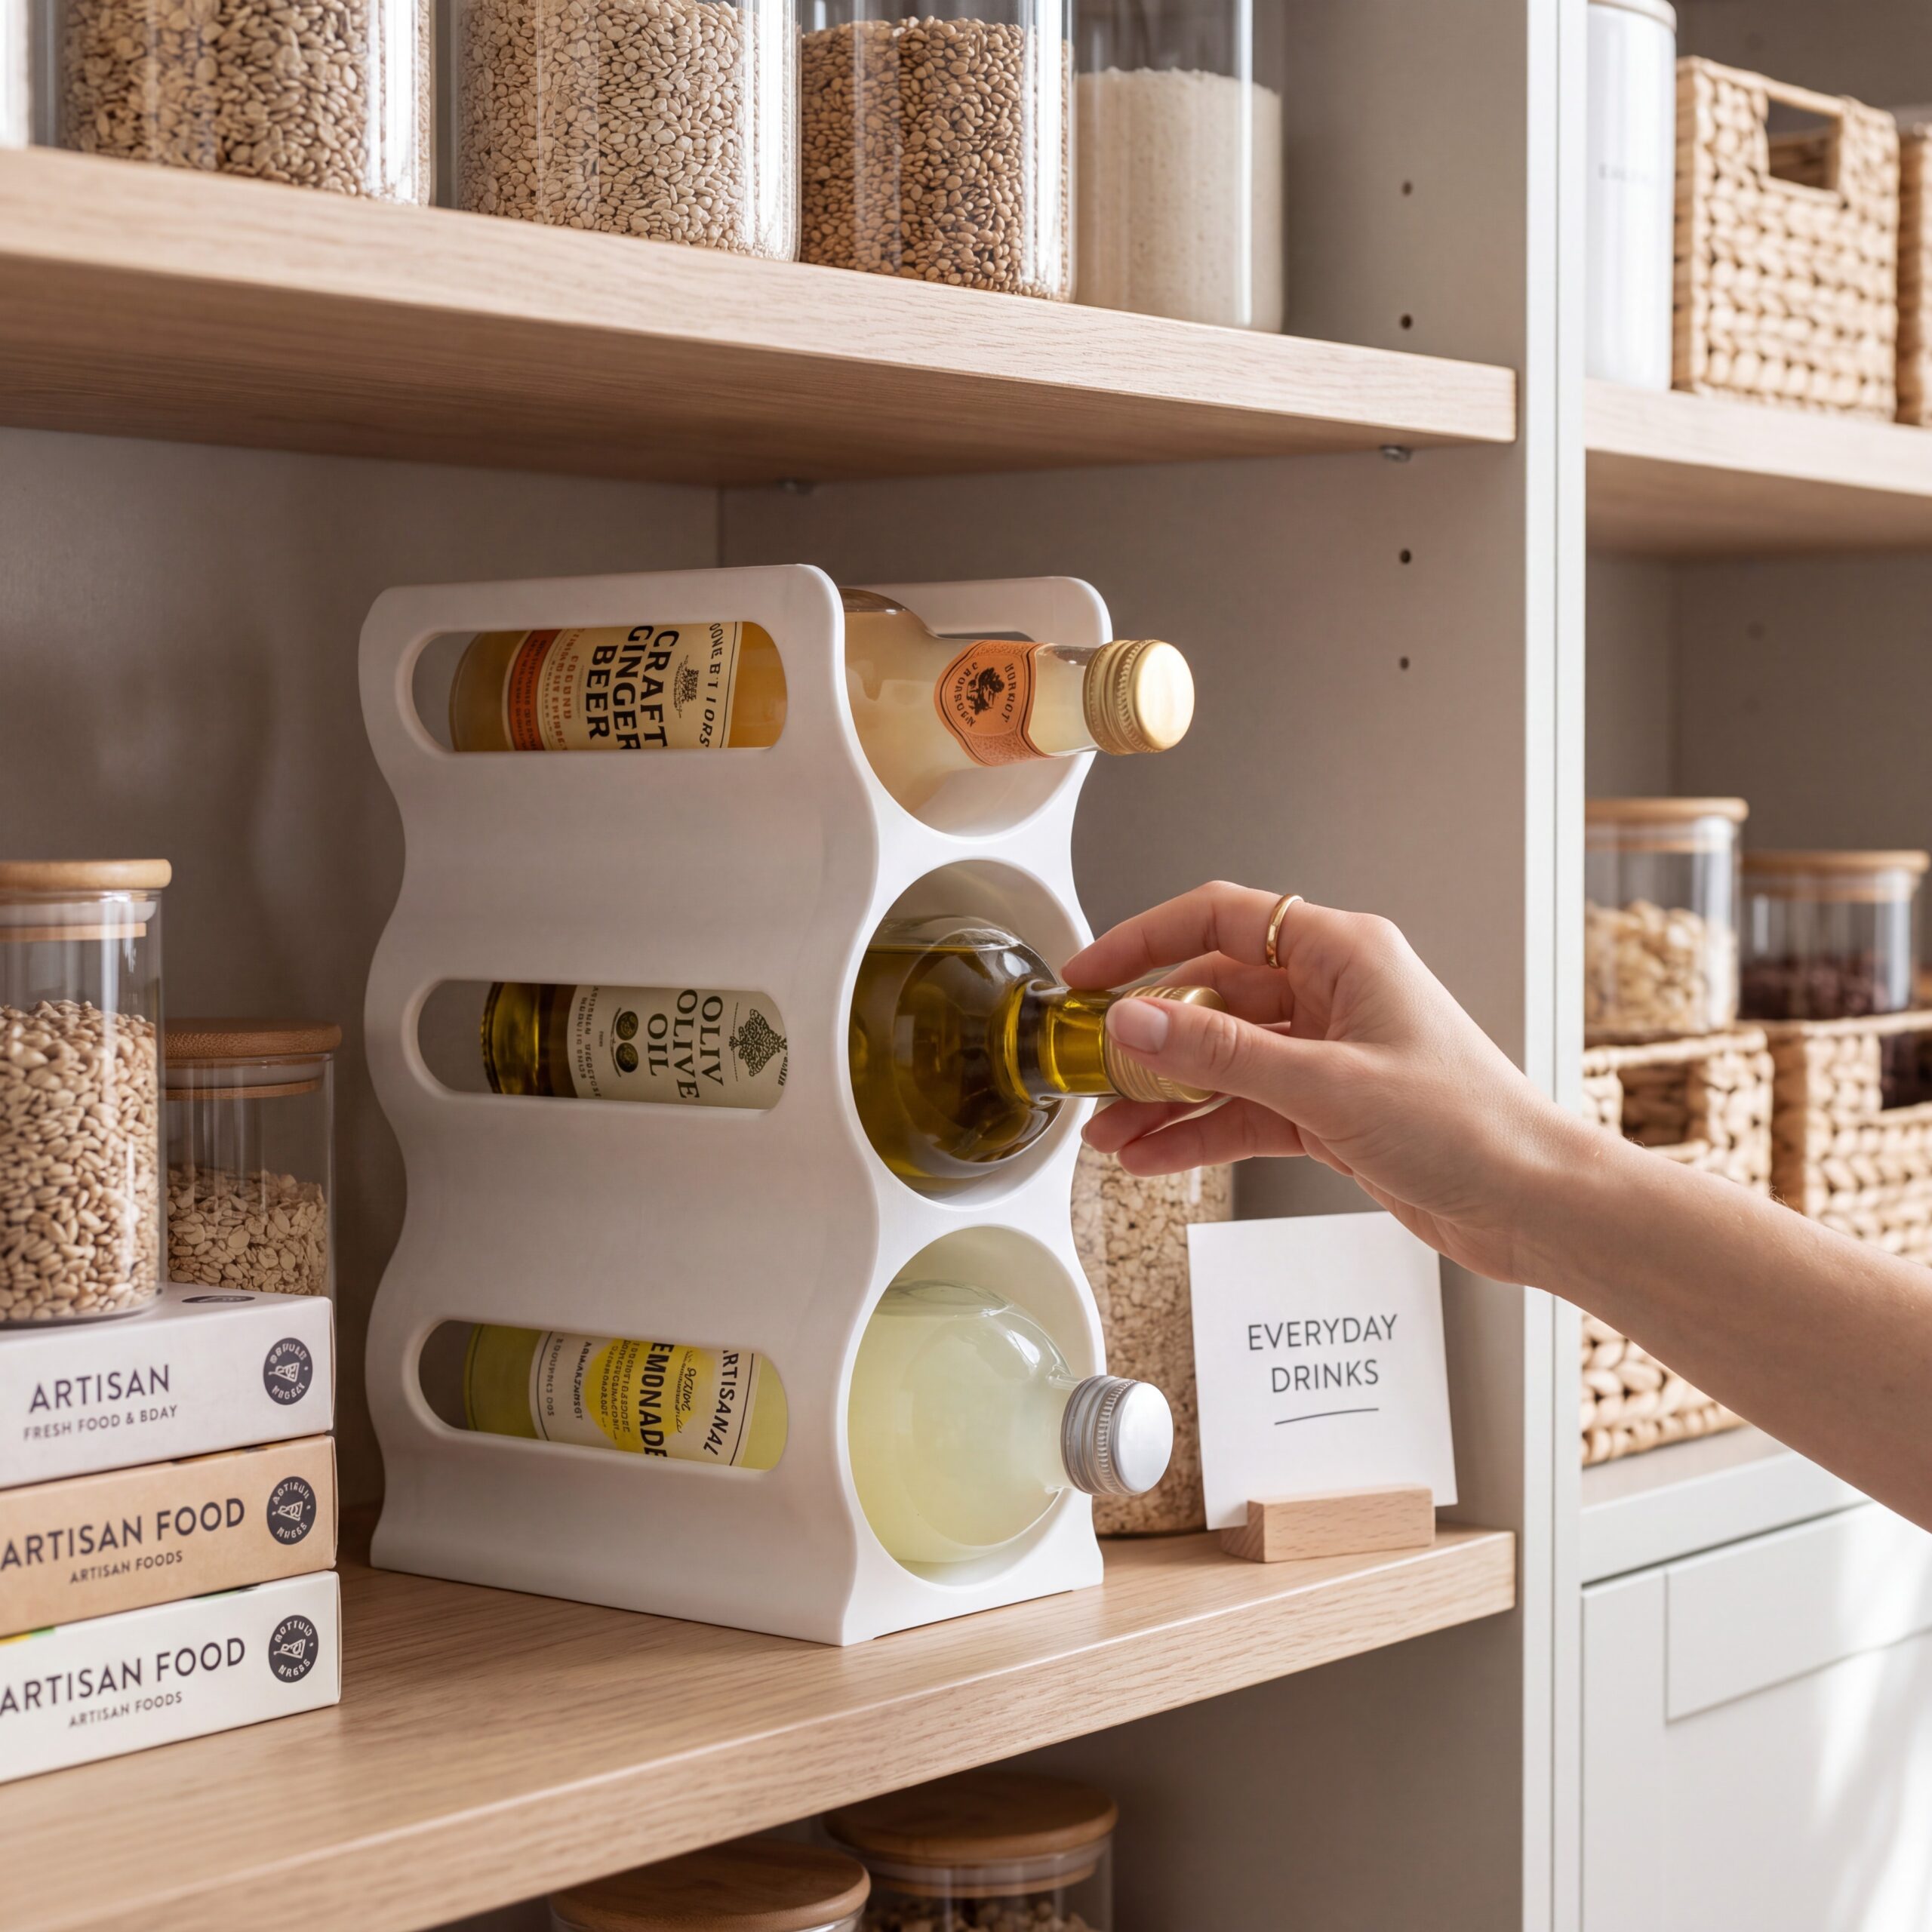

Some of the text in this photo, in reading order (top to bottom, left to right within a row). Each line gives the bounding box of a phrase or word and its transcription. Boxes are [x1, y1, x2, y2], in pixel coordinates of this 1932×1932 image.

[585, 645, 620, 740] BEER
[612, 625, 655, 749] GINGER
[640, 630, 681, 748] CRAFT
[647, 1013, 670, 1078] OIL
[672, 989, 700, 1100] OLIVE
[699, 995, 724, 1087] OLIV
[1247, 1313, 1398, 1351] EVERYDAY
[28, 1364, 171, 1414] ARTISAN
[638, 1342, 675, 1457] EMONADE
[703, 1349, 740, 1456] RTISANAL
[1271, 1359, 1380, 1393] DRINKS
[23, 1404, 178, 1441] FRESH FOOD & BDAY
[0, 1497, 245, 1572] ARTISAN FOOD
[69, 1550, 183, 1585] ARTISAN FOODS
[0, 1637, 245, 1717] ARTISAN FOOD
[69, 1690, 183, 1728] ARTISAN FOODS
